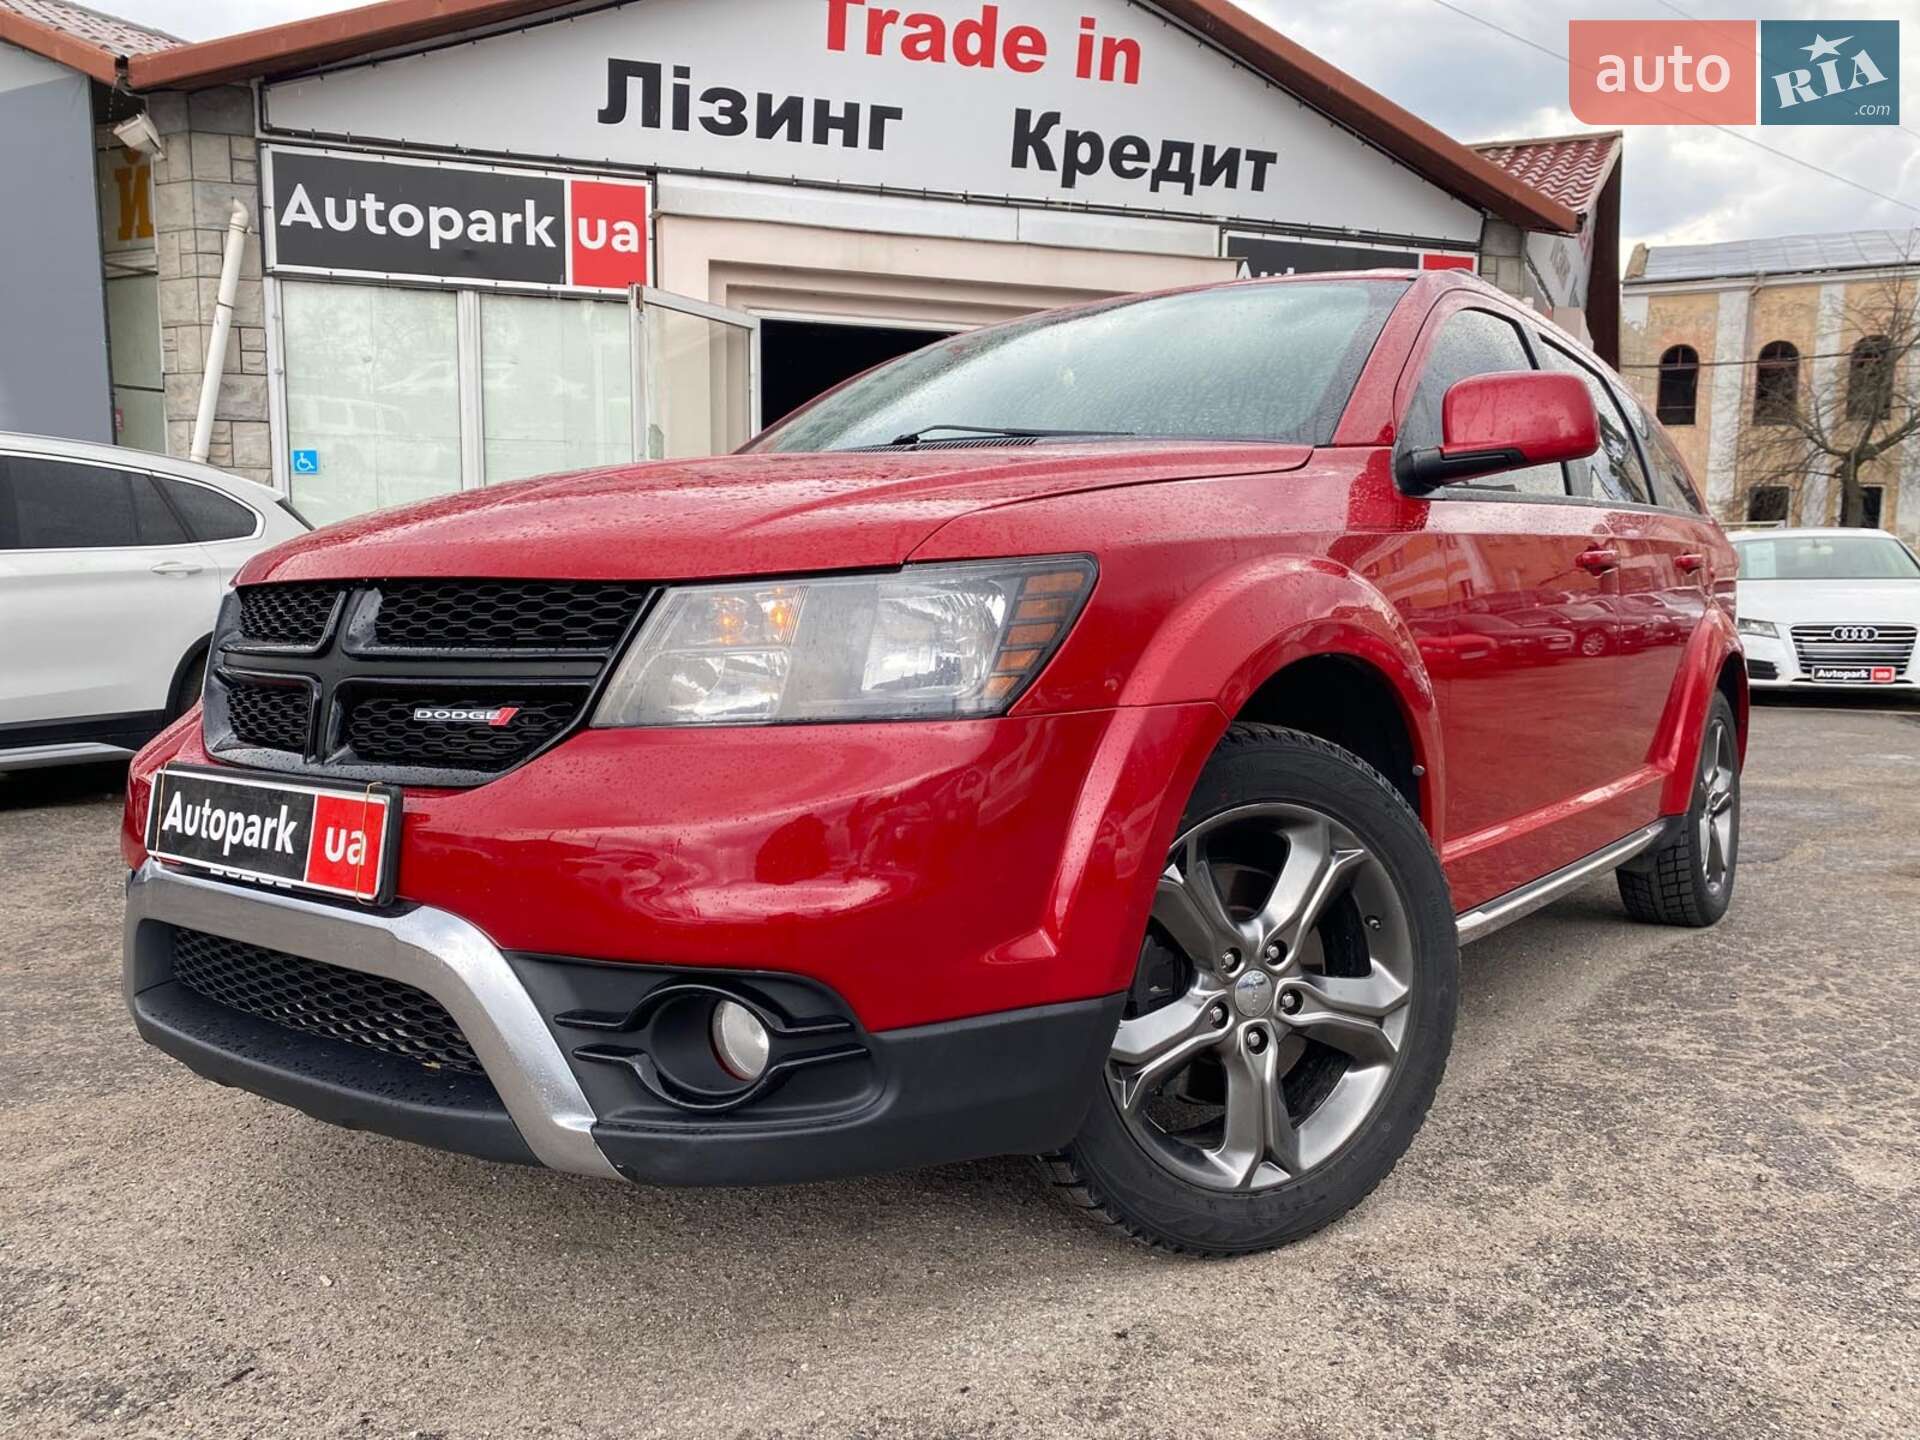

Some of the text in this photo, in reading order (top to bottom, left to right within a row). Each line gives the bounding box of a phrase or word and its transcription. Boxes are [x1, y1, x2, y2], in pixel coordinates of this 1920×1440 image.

[826, 0, 1142, 85] Trade in
[598, 57, 1278, 196] Лізинг Кредит
[279, 182, 640, 254] Autopark ua
[1817, 668, 1869, 680] Autopark
[416, 709, 501, 721] DODGE
[161, 790, 368, 867] Autopark ua
